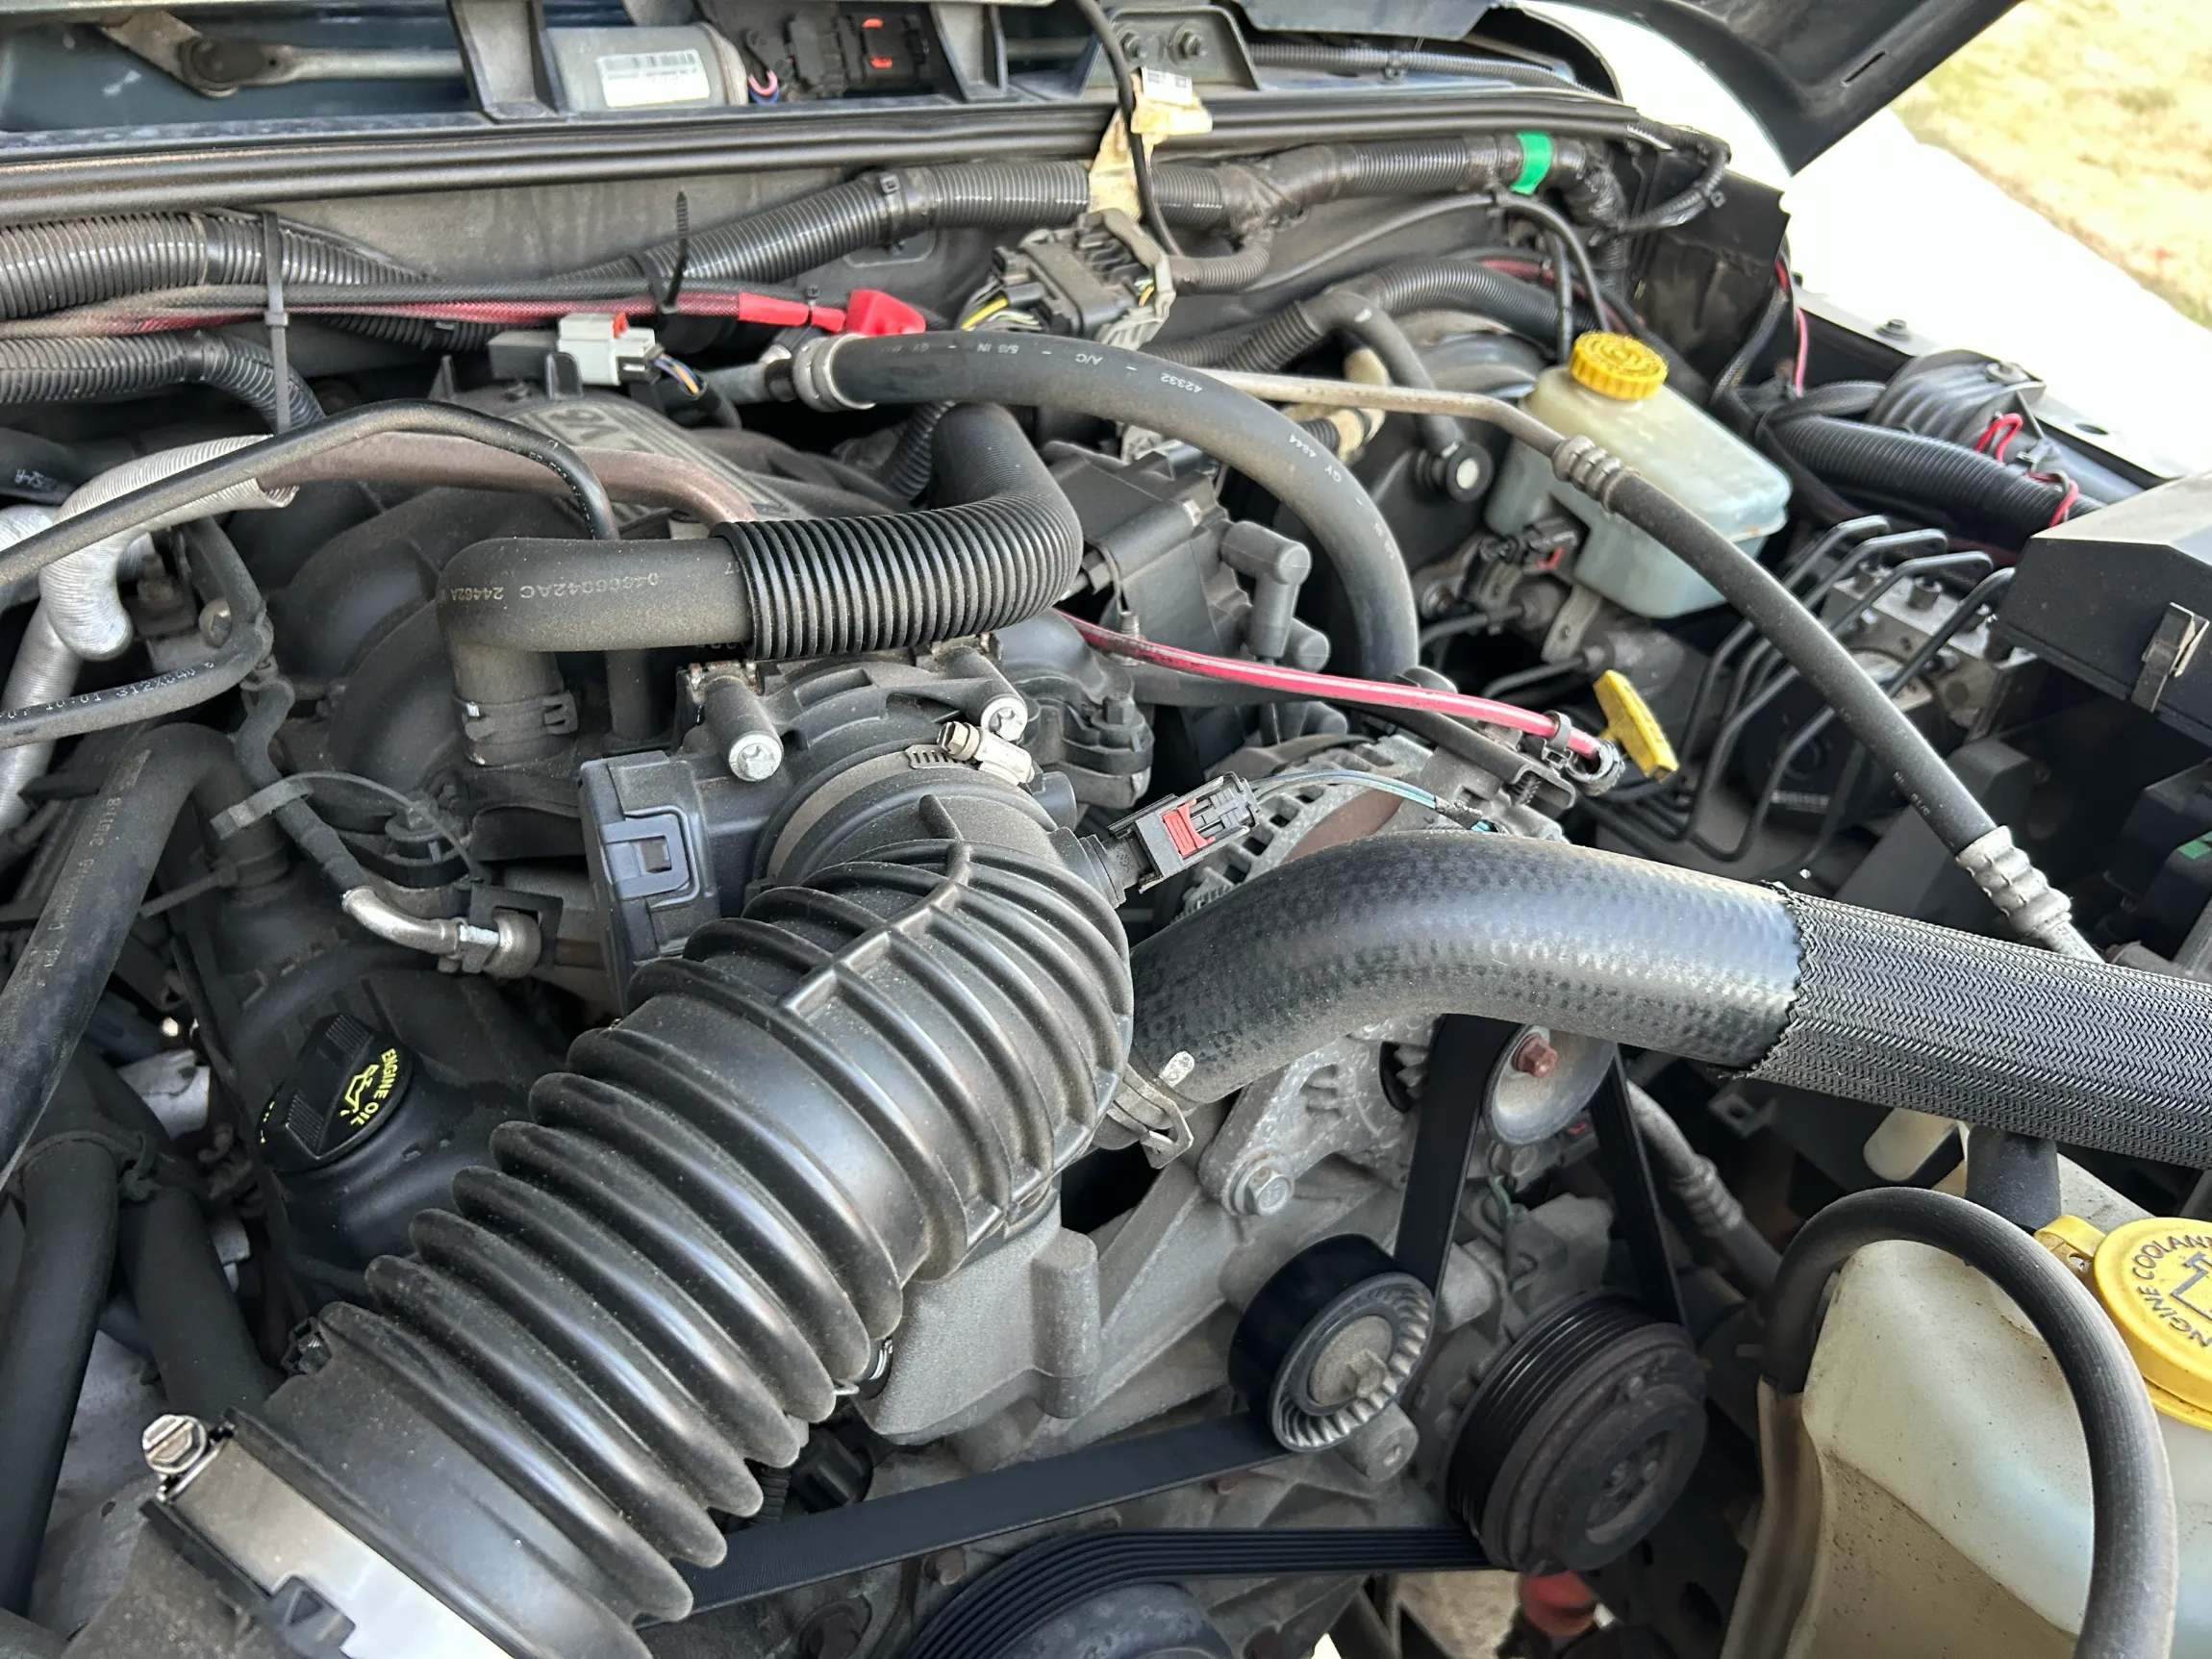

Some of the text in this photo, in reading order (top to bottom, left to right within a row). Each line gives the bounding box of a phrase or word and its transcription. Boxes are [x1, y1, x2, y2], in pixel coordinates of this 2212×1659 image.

[1074, 353, 1103, 366] A/C
[1160, 372, 1203, 393] 42332
[450, 586, 504, 601] 24462A
[350, 1047, 398, 1125] ENGINE OIL
[2137, 1285, 2212, 1348] NGINE
